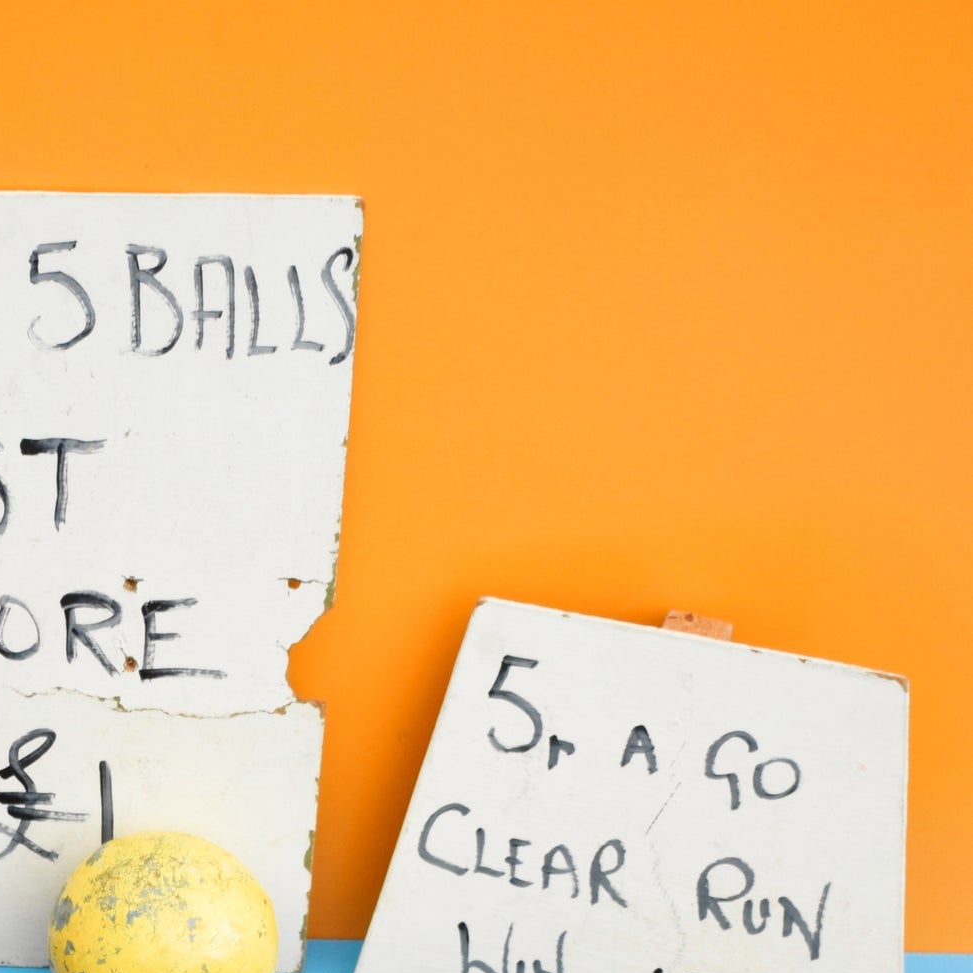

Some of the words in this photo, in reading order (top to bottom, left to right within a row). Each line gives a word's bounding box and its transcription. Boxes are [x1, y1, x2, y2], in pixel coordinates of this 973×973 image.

[28, 240, 96, 350] 5
[125, 244, 356, 365] BALLS
[620, 724, 659, 775] A
[704, 730, 801, 811] GO
[418, 802, 628, 909] CLEAR
[696, 857, 832, 961] RUN
